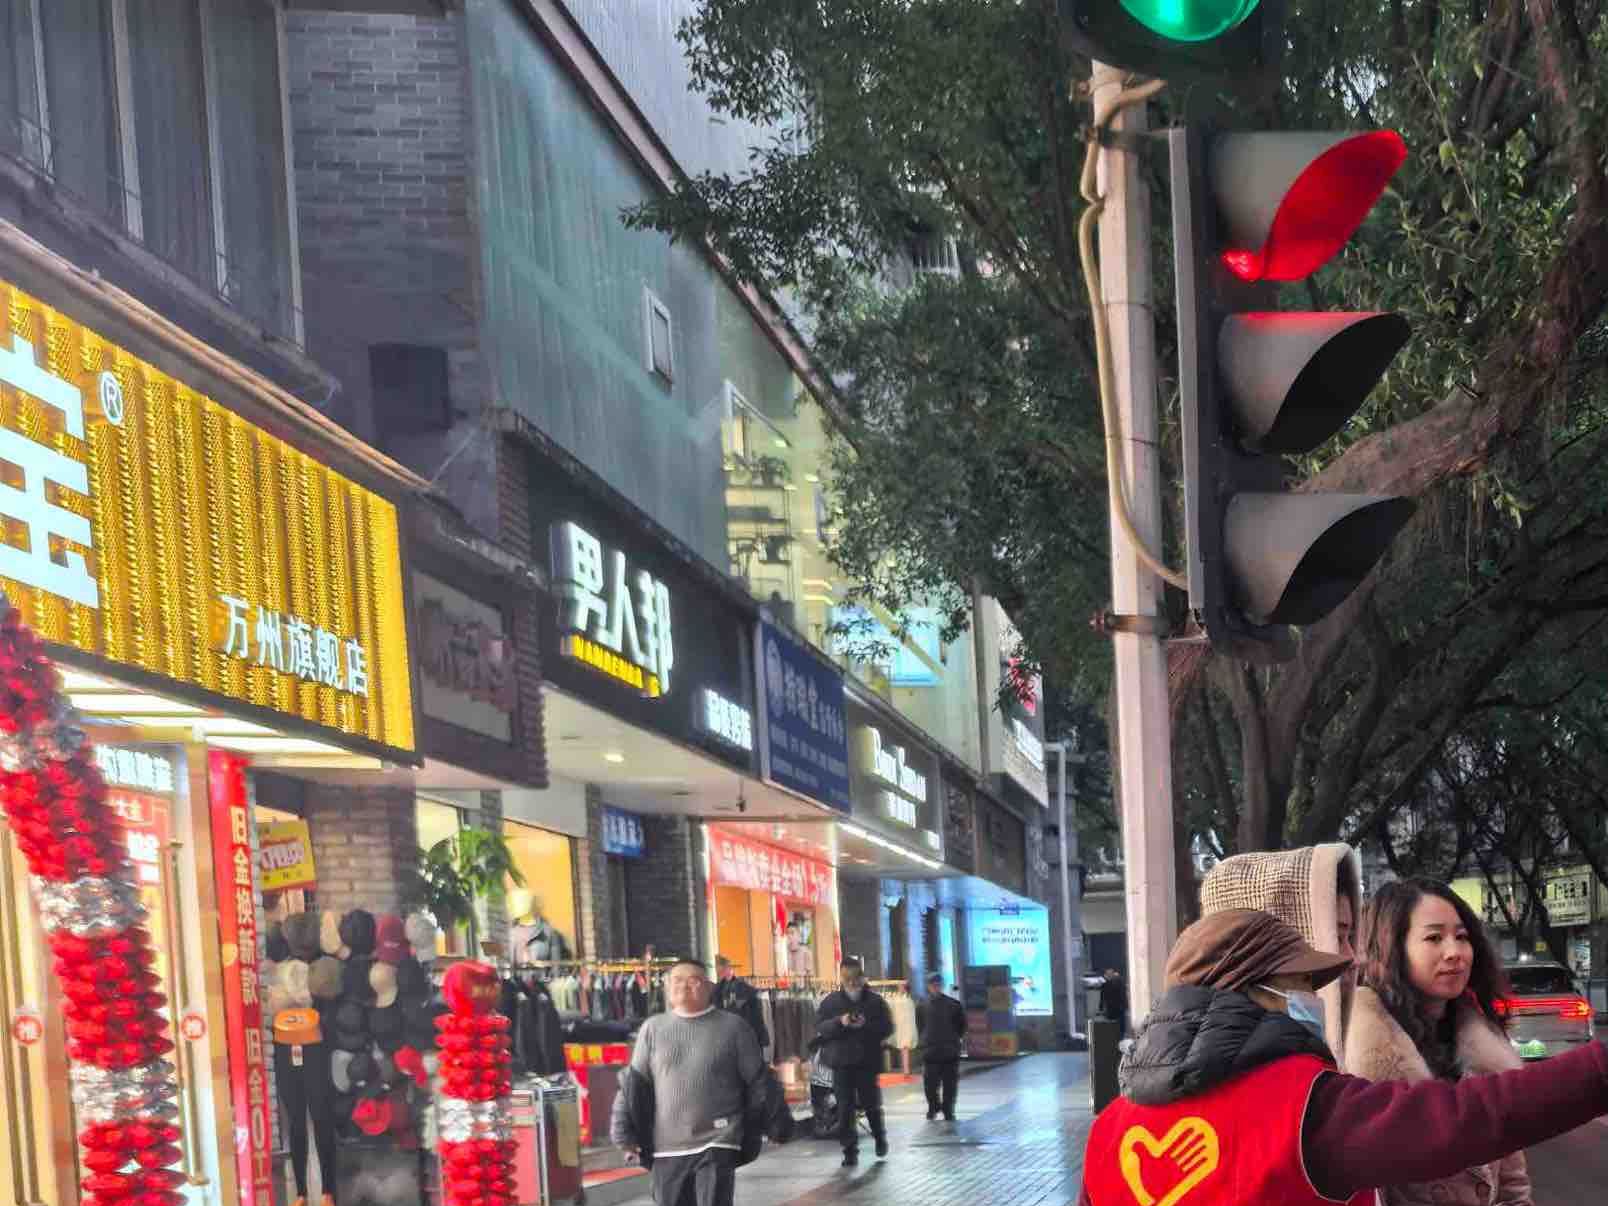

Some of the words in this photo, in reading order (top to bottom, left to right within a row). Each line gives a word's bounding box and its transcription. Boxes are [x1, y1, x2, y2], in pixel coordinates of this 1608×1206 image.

[222, 593, 369, 698] 万州旗舰店
